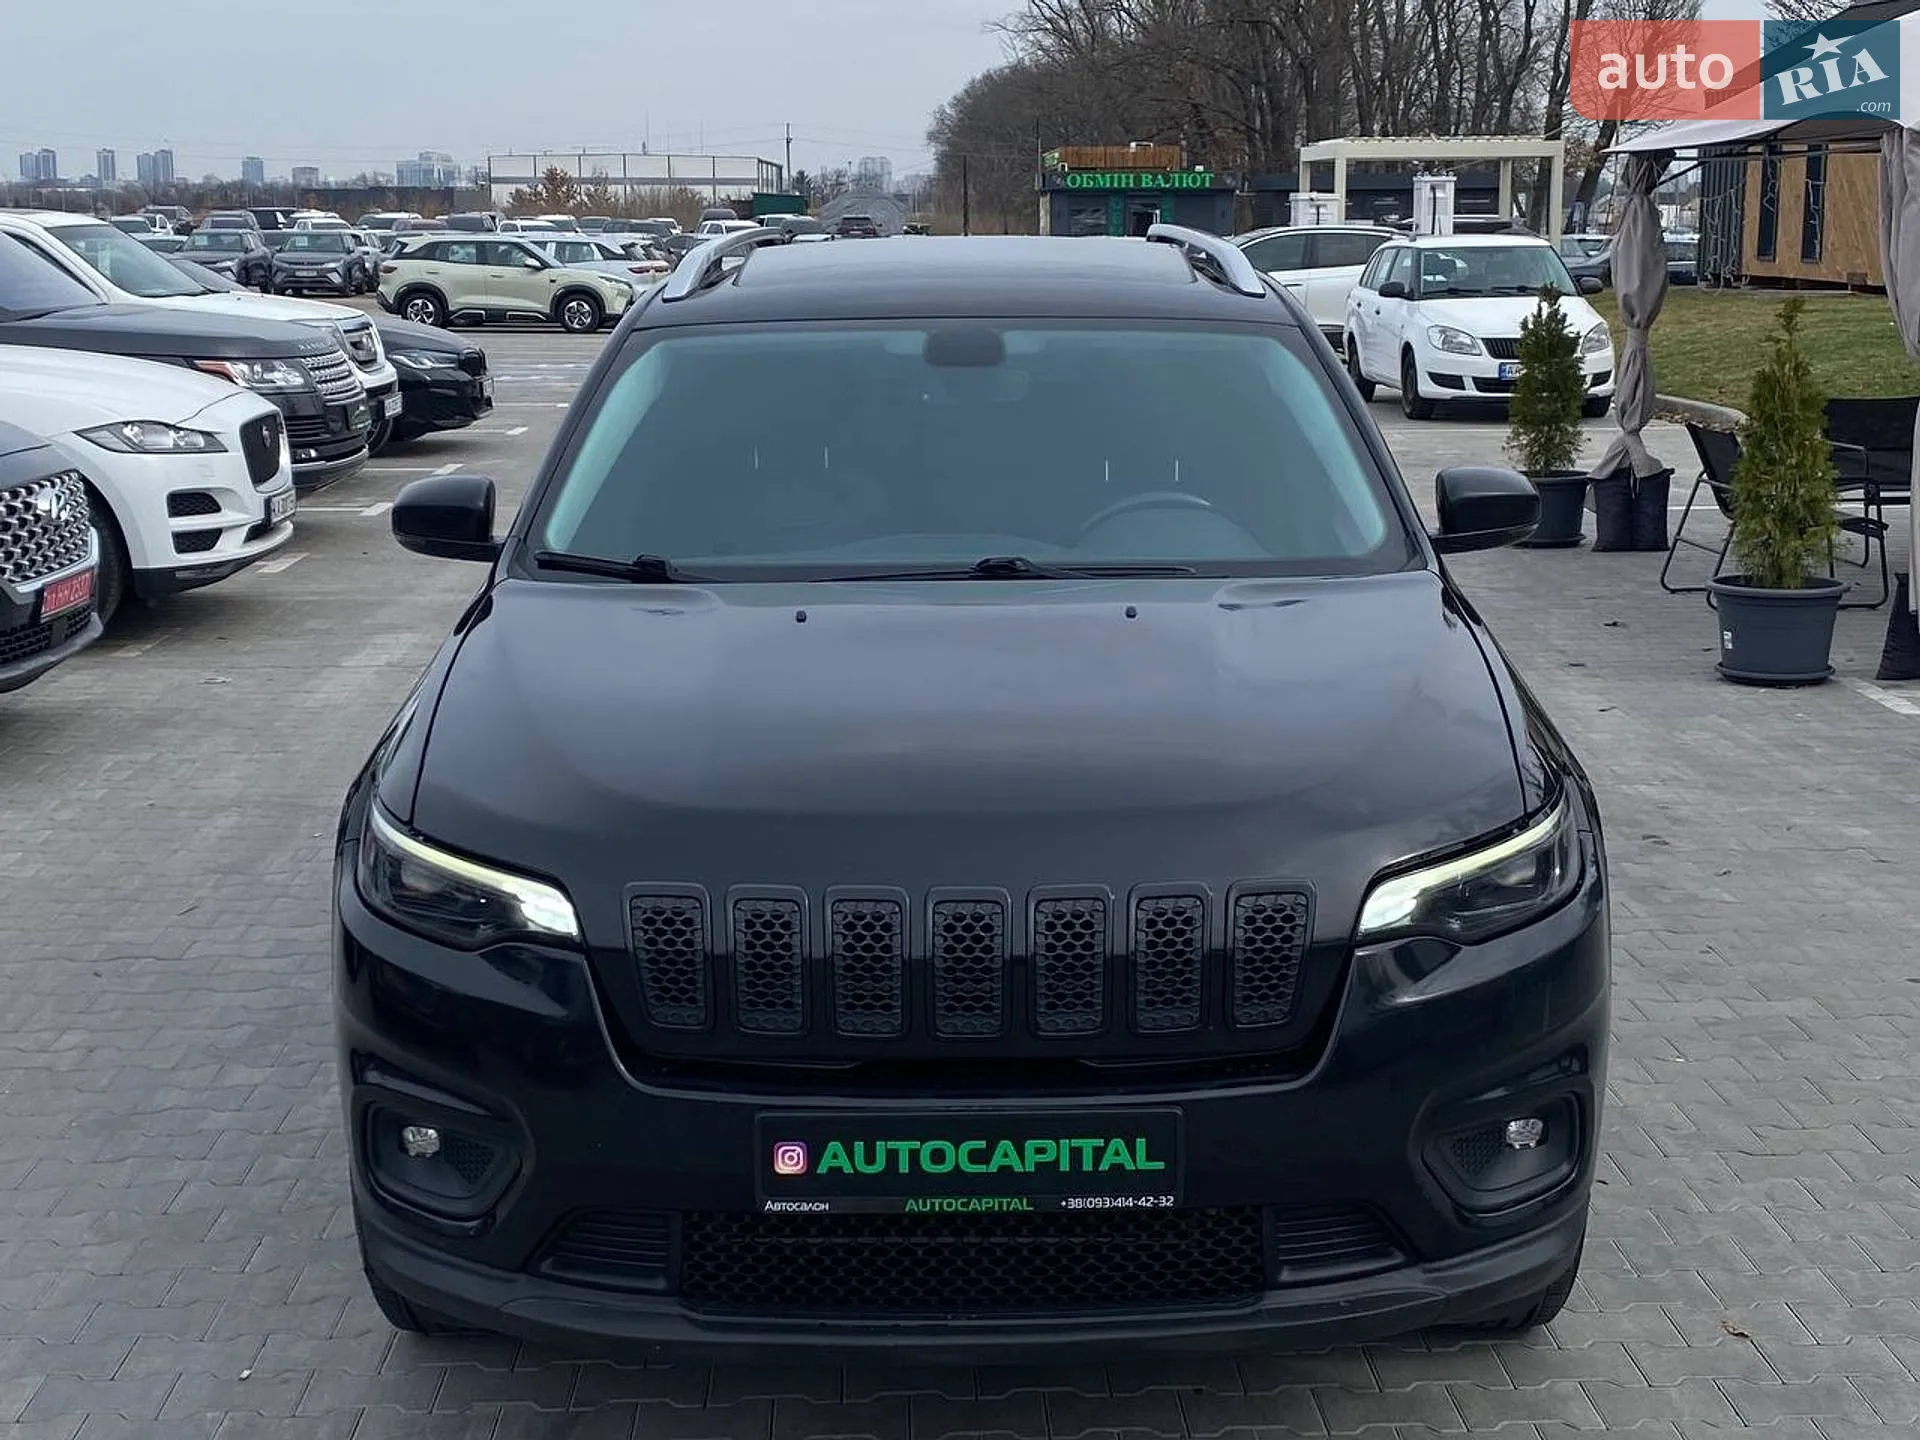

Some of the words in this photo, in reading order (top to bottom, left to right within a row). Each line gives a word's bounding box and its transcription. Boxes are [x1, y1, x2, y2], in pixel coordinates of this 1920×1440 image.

[1066, 172, 1134, 189] ОБМІН
[1140, 172, 1214, 188] ВАЛЮТ
[816, 1139, 1166, 1174] AUTOCAPITAL
[764, 1200, 829, 1212] Автосалон
[905, 1198, 1033, 1211] AUTOCAPITAL
[1061, 1196, 1174, 1209] +38(093)414-42-32
